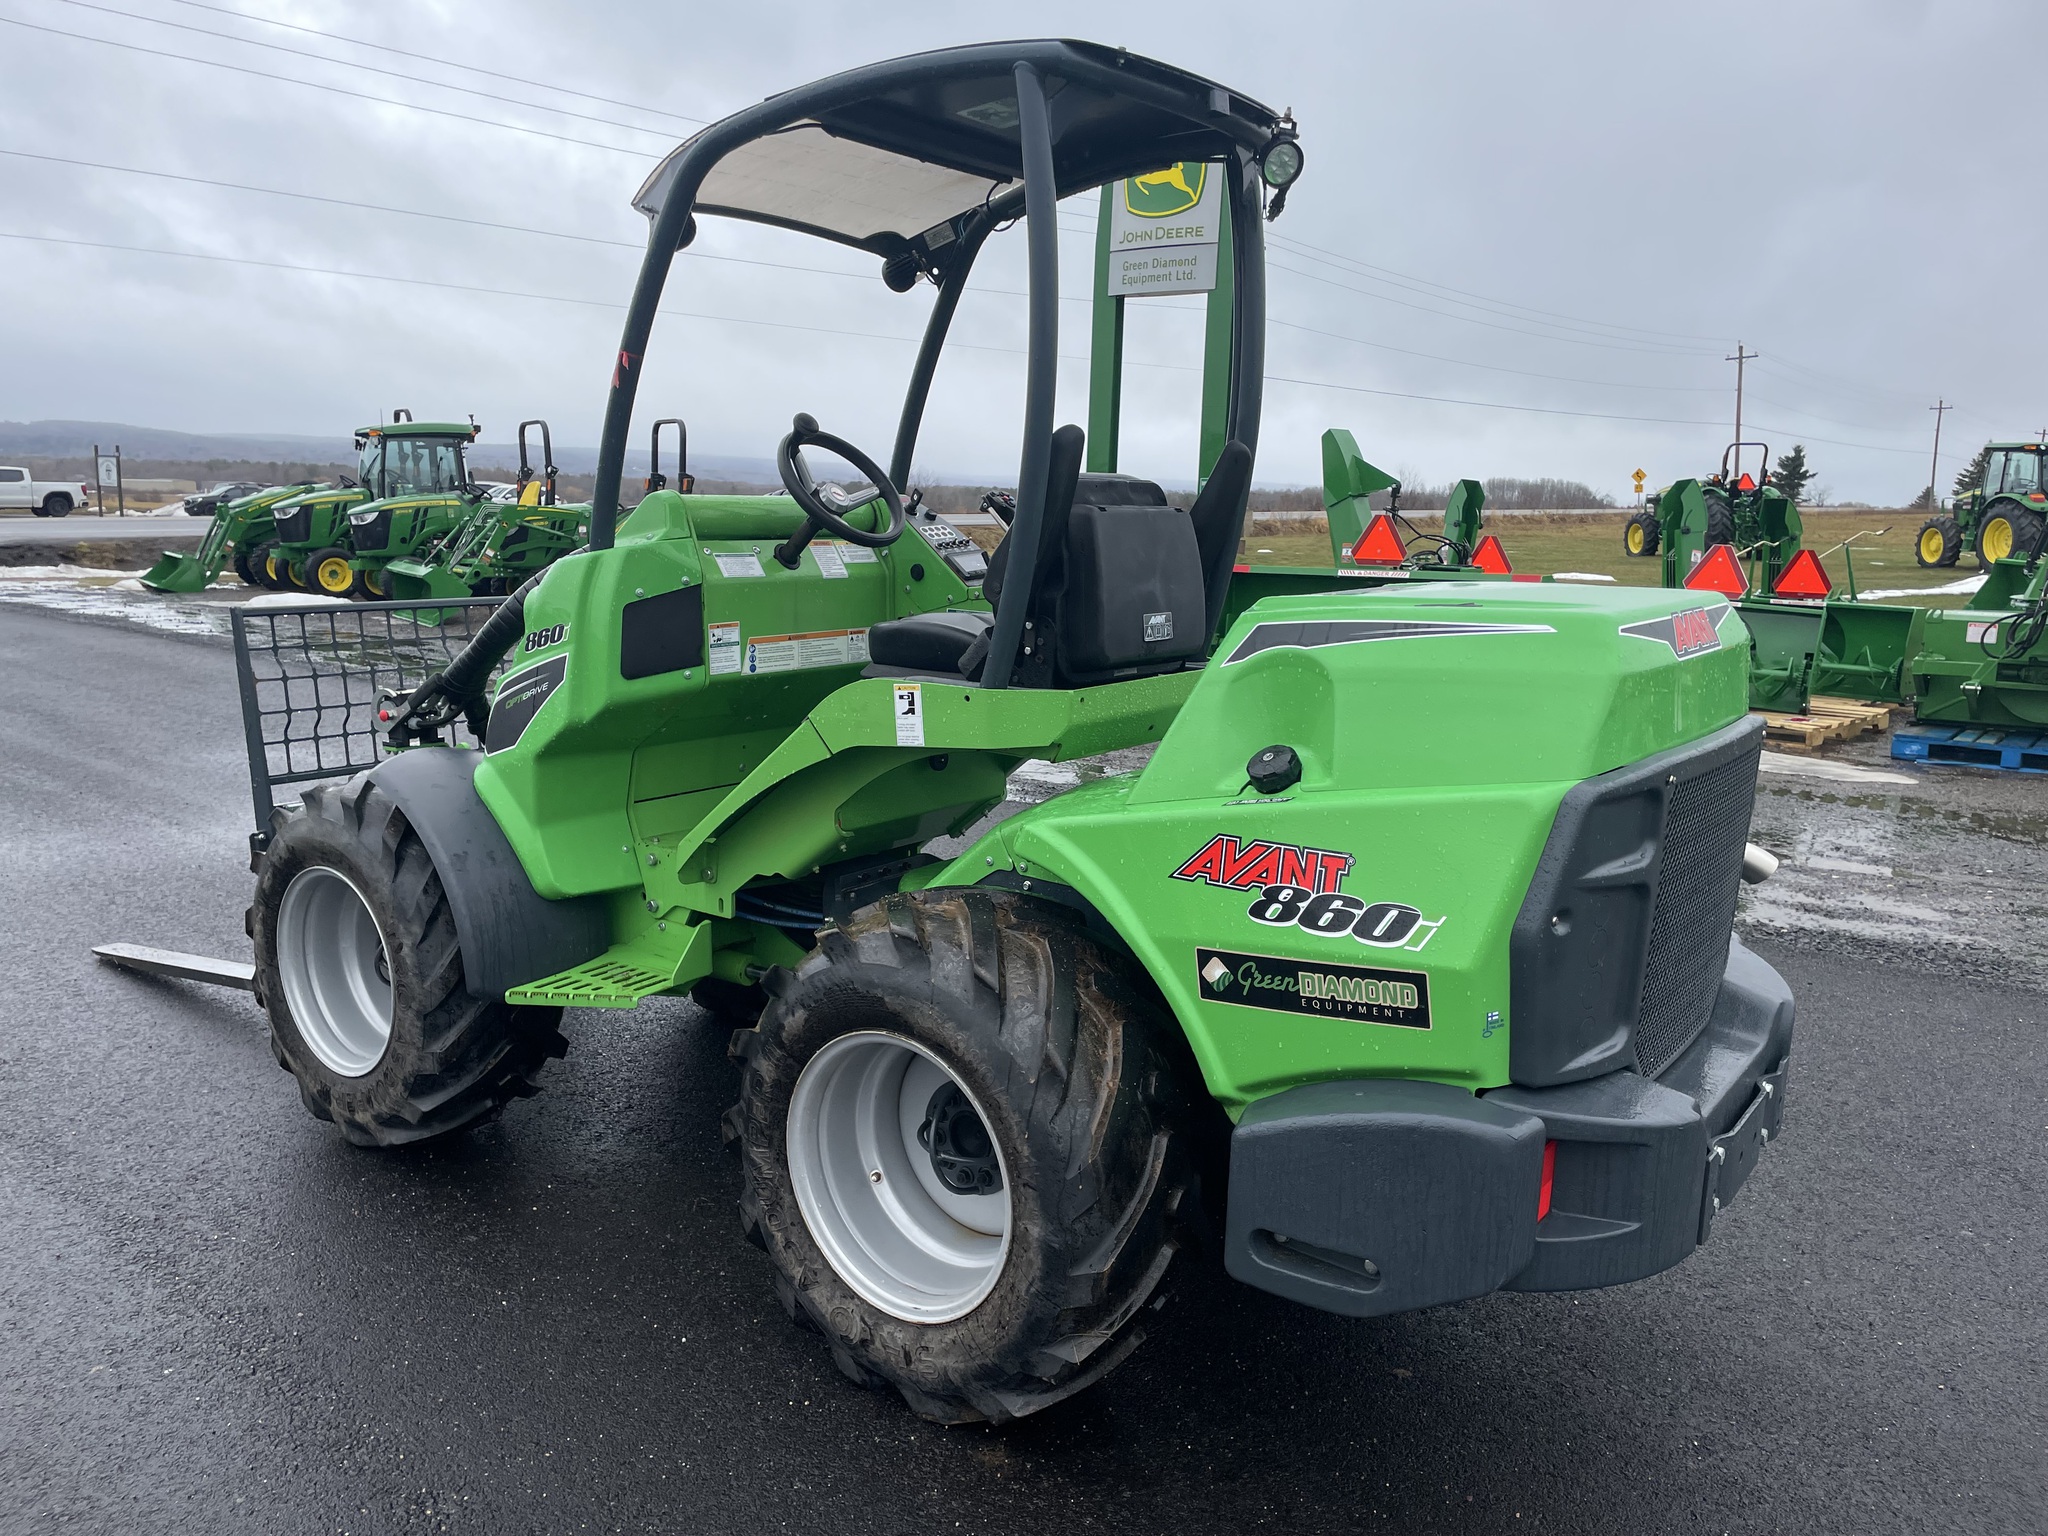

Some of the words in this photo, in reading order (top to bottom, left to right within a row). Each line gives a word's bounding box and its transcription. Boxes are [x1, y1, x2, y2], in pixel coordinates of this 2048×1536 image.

[1119, 230, 1152, 244] JOHN
[1155, 226, 1204, 240] DEERE
[1123, 259, 1148, 271] Green
[1152, 256, 1197, 269] Diamond
[1122, 271, 1172, 286] Equipment
[1176, 270, 1196, 280] Ltd.
[505, 682, 549, 709] OPTIDRIVE
[1168, 833, 1353, 895] AVANT
[1247, 884, 1447, 952] 860i
[1238, 961, 1300, 996] Green
[1298, 971, 1418, 1009] DIAMOND
[1301, 999, 1404, 1018] EQUIPMENT
